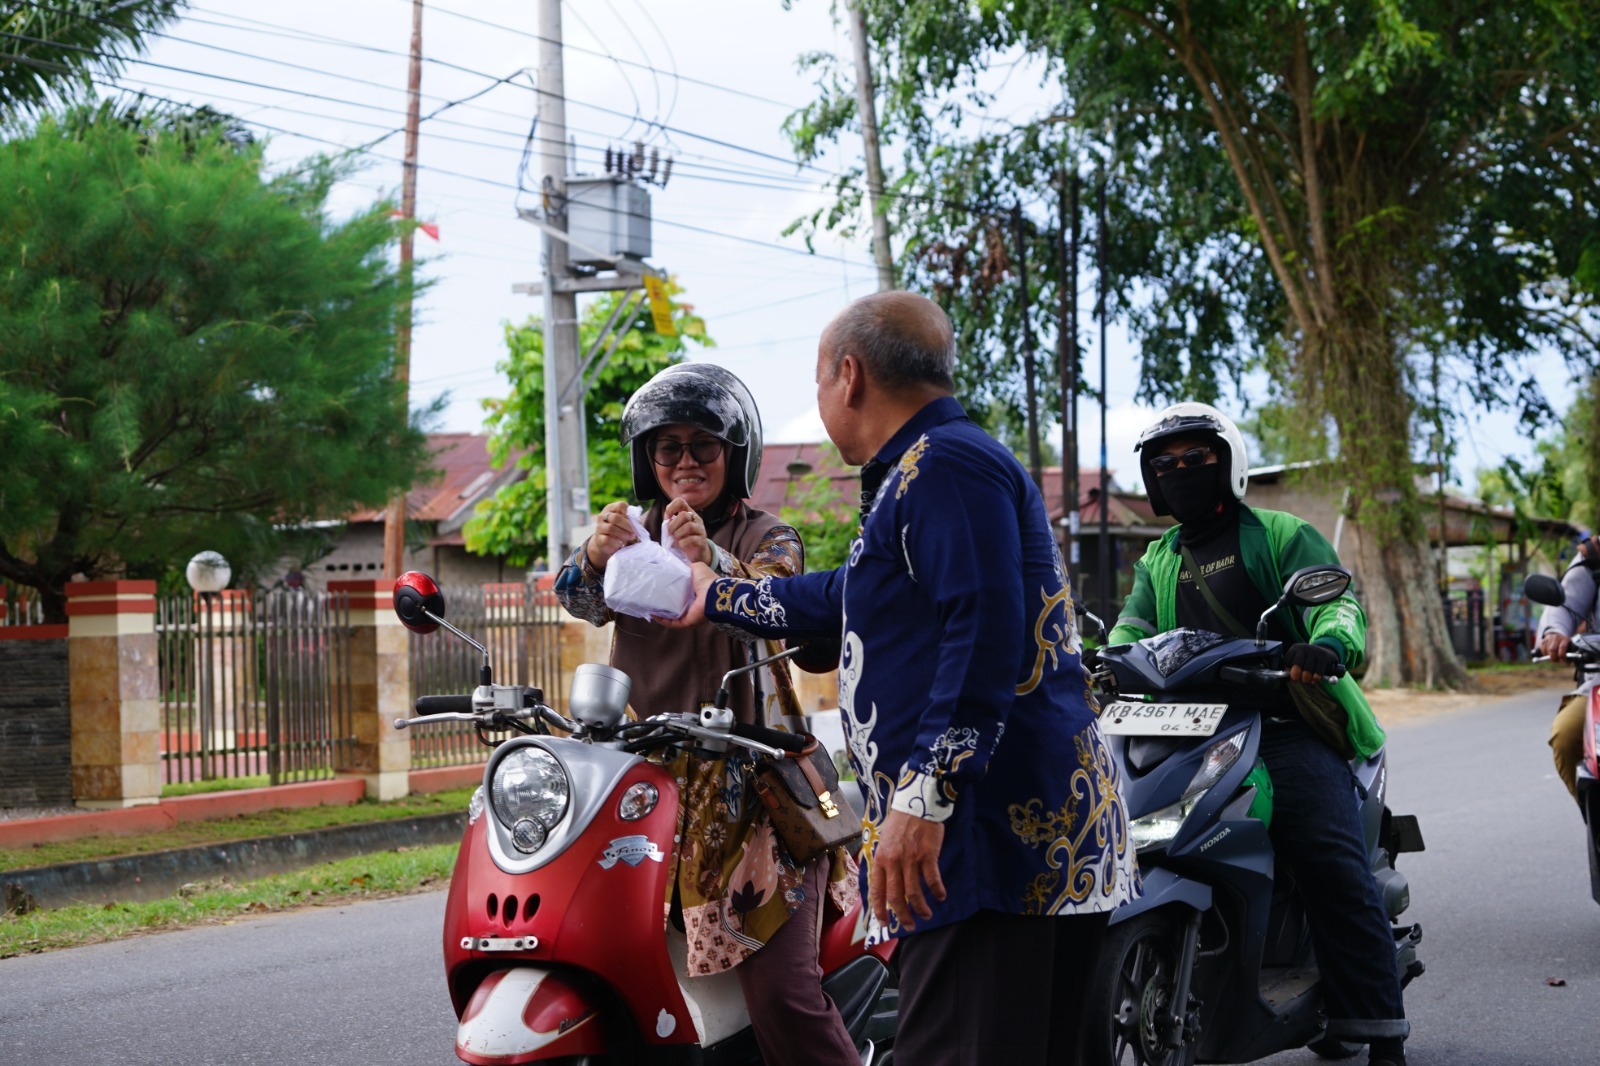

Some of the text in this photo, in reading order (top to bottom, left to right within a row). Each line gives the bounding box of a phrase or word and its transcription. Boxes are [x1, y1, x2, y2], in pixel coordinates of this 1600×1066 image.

[1205, 562, 1216, 573] OF
[1183, 706, 1223, 719] MAE
[1200, 827, 1231, 852] HONDA
